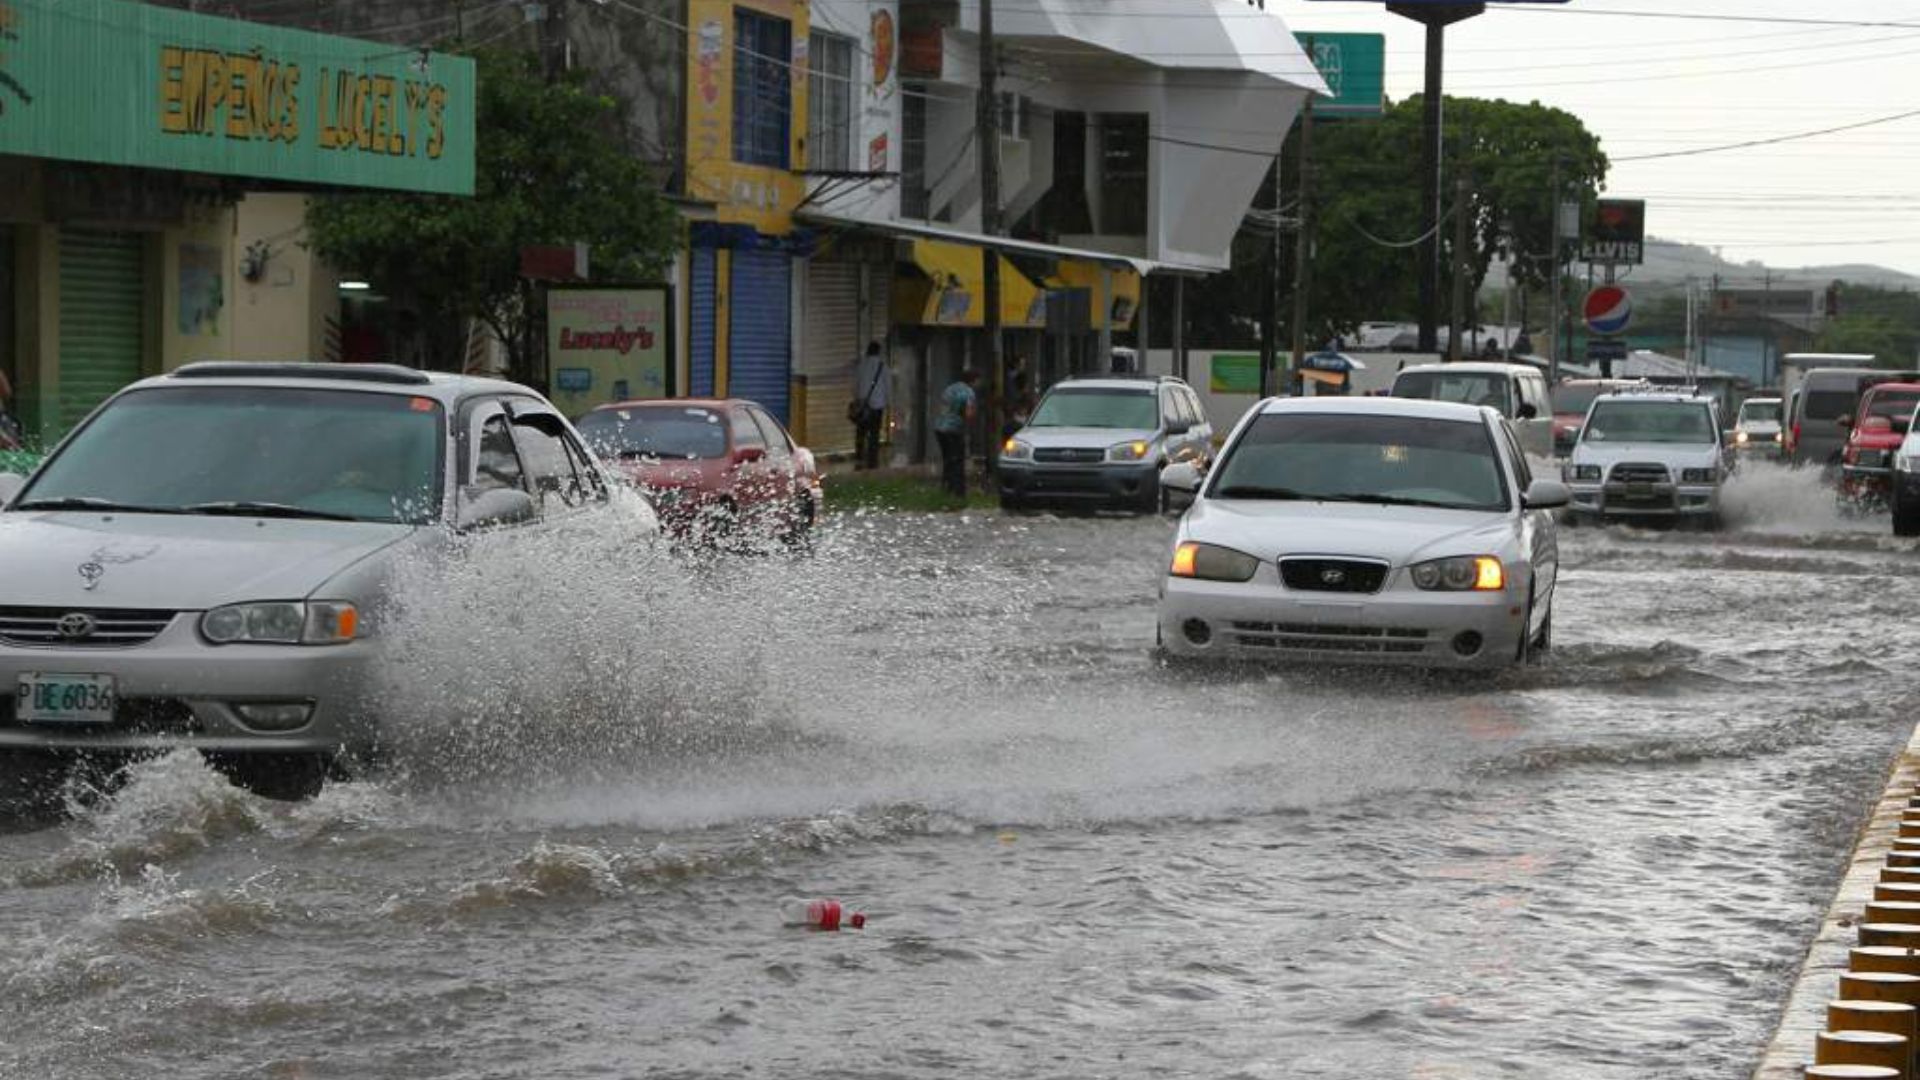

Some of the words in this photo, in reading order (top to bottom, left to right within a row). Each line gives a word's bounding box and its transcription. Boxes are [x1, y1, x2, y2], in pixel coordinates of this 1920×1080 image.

[161, 45, 299, 144] EMPEÑOS
[318, 66, 446, 159] LUCELY'S
[559, 325, 655, 355] Lucely's
